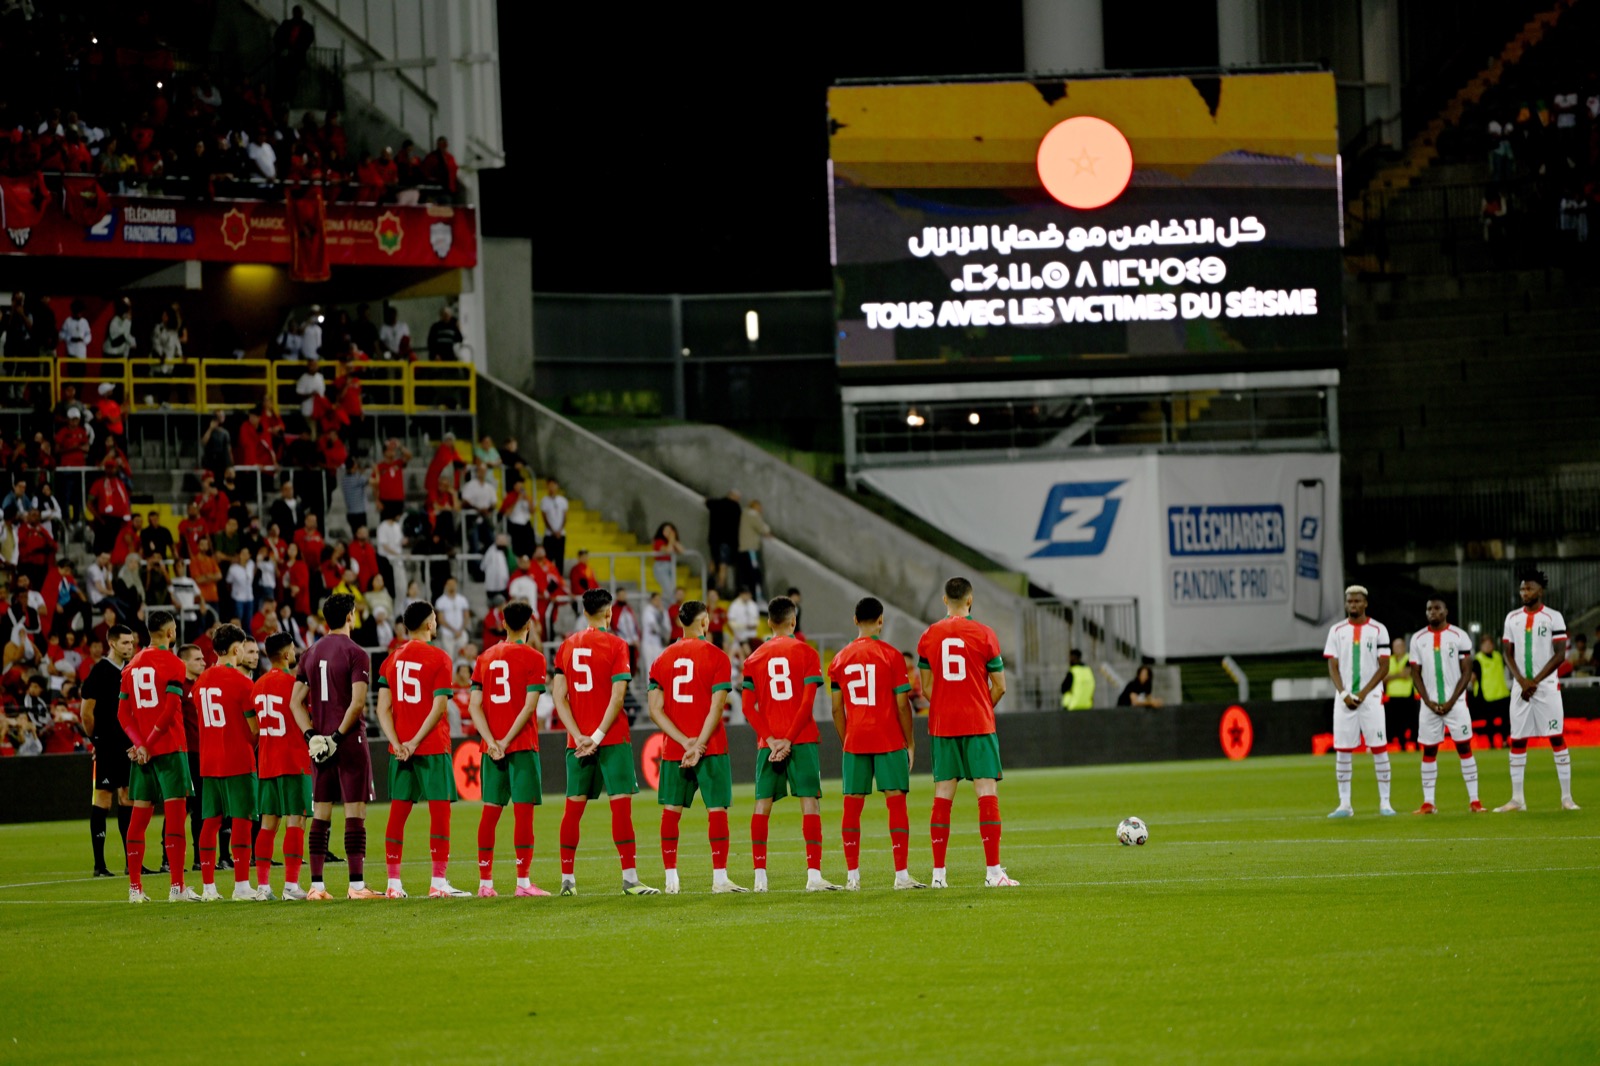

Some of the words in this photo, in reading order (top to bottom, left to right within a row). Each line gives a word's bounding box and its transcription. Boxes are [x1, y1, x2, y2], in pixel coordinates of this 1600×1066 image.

[161, 226, 178, 243] PRO
[908, 225, 988, 257] الزلزال
[990, 223, 1064, 254] ضحايا
[1065, 226, 1107, 251] مع
[1108, 218, 1215, 251] التضامن
[1215, 216, 1266, 247] كل
[861, 301, 935, 329] TOUS
[936, 299, 1006, 327] AVEC
[1008, 297, 1055, 325] LES
[1056, 293, 1178, 323] VICTIMES
[1180, 292, 1222, 319] DU
[1225, 286, 1318, 318] SÉISME
[1170, 505, 1284, 552] TÉLÉCHARGER
[1174, 568, 1237, 600] FANZONE
[1241, 567, 1268, 598] PRO
[1366, 641, 1373, 652] 4
[1537, 625, 1548, 637] 12
[572, 648, 593, 692] 5
[941, 637, 967, 681] 6
[1449, 647, 1455, 658] 2
[131, 666, 159, 709] 19
[318, 659, 329, 701] 1
[395, 660, 423, 703] 15
[489, 659, 511, 703] 3
[672, 657, 694, 703] 2
[767, 656, 793, 701] 8
[844, 663, 876, 706] 21
[199, 687, 226, 728] 16
[254, 694, 286, 737] 25
[1548, 719, 1558, 731] 12
[1376, 730, 1383, 741] 4
[1460, 724, 1469, 736] 2
